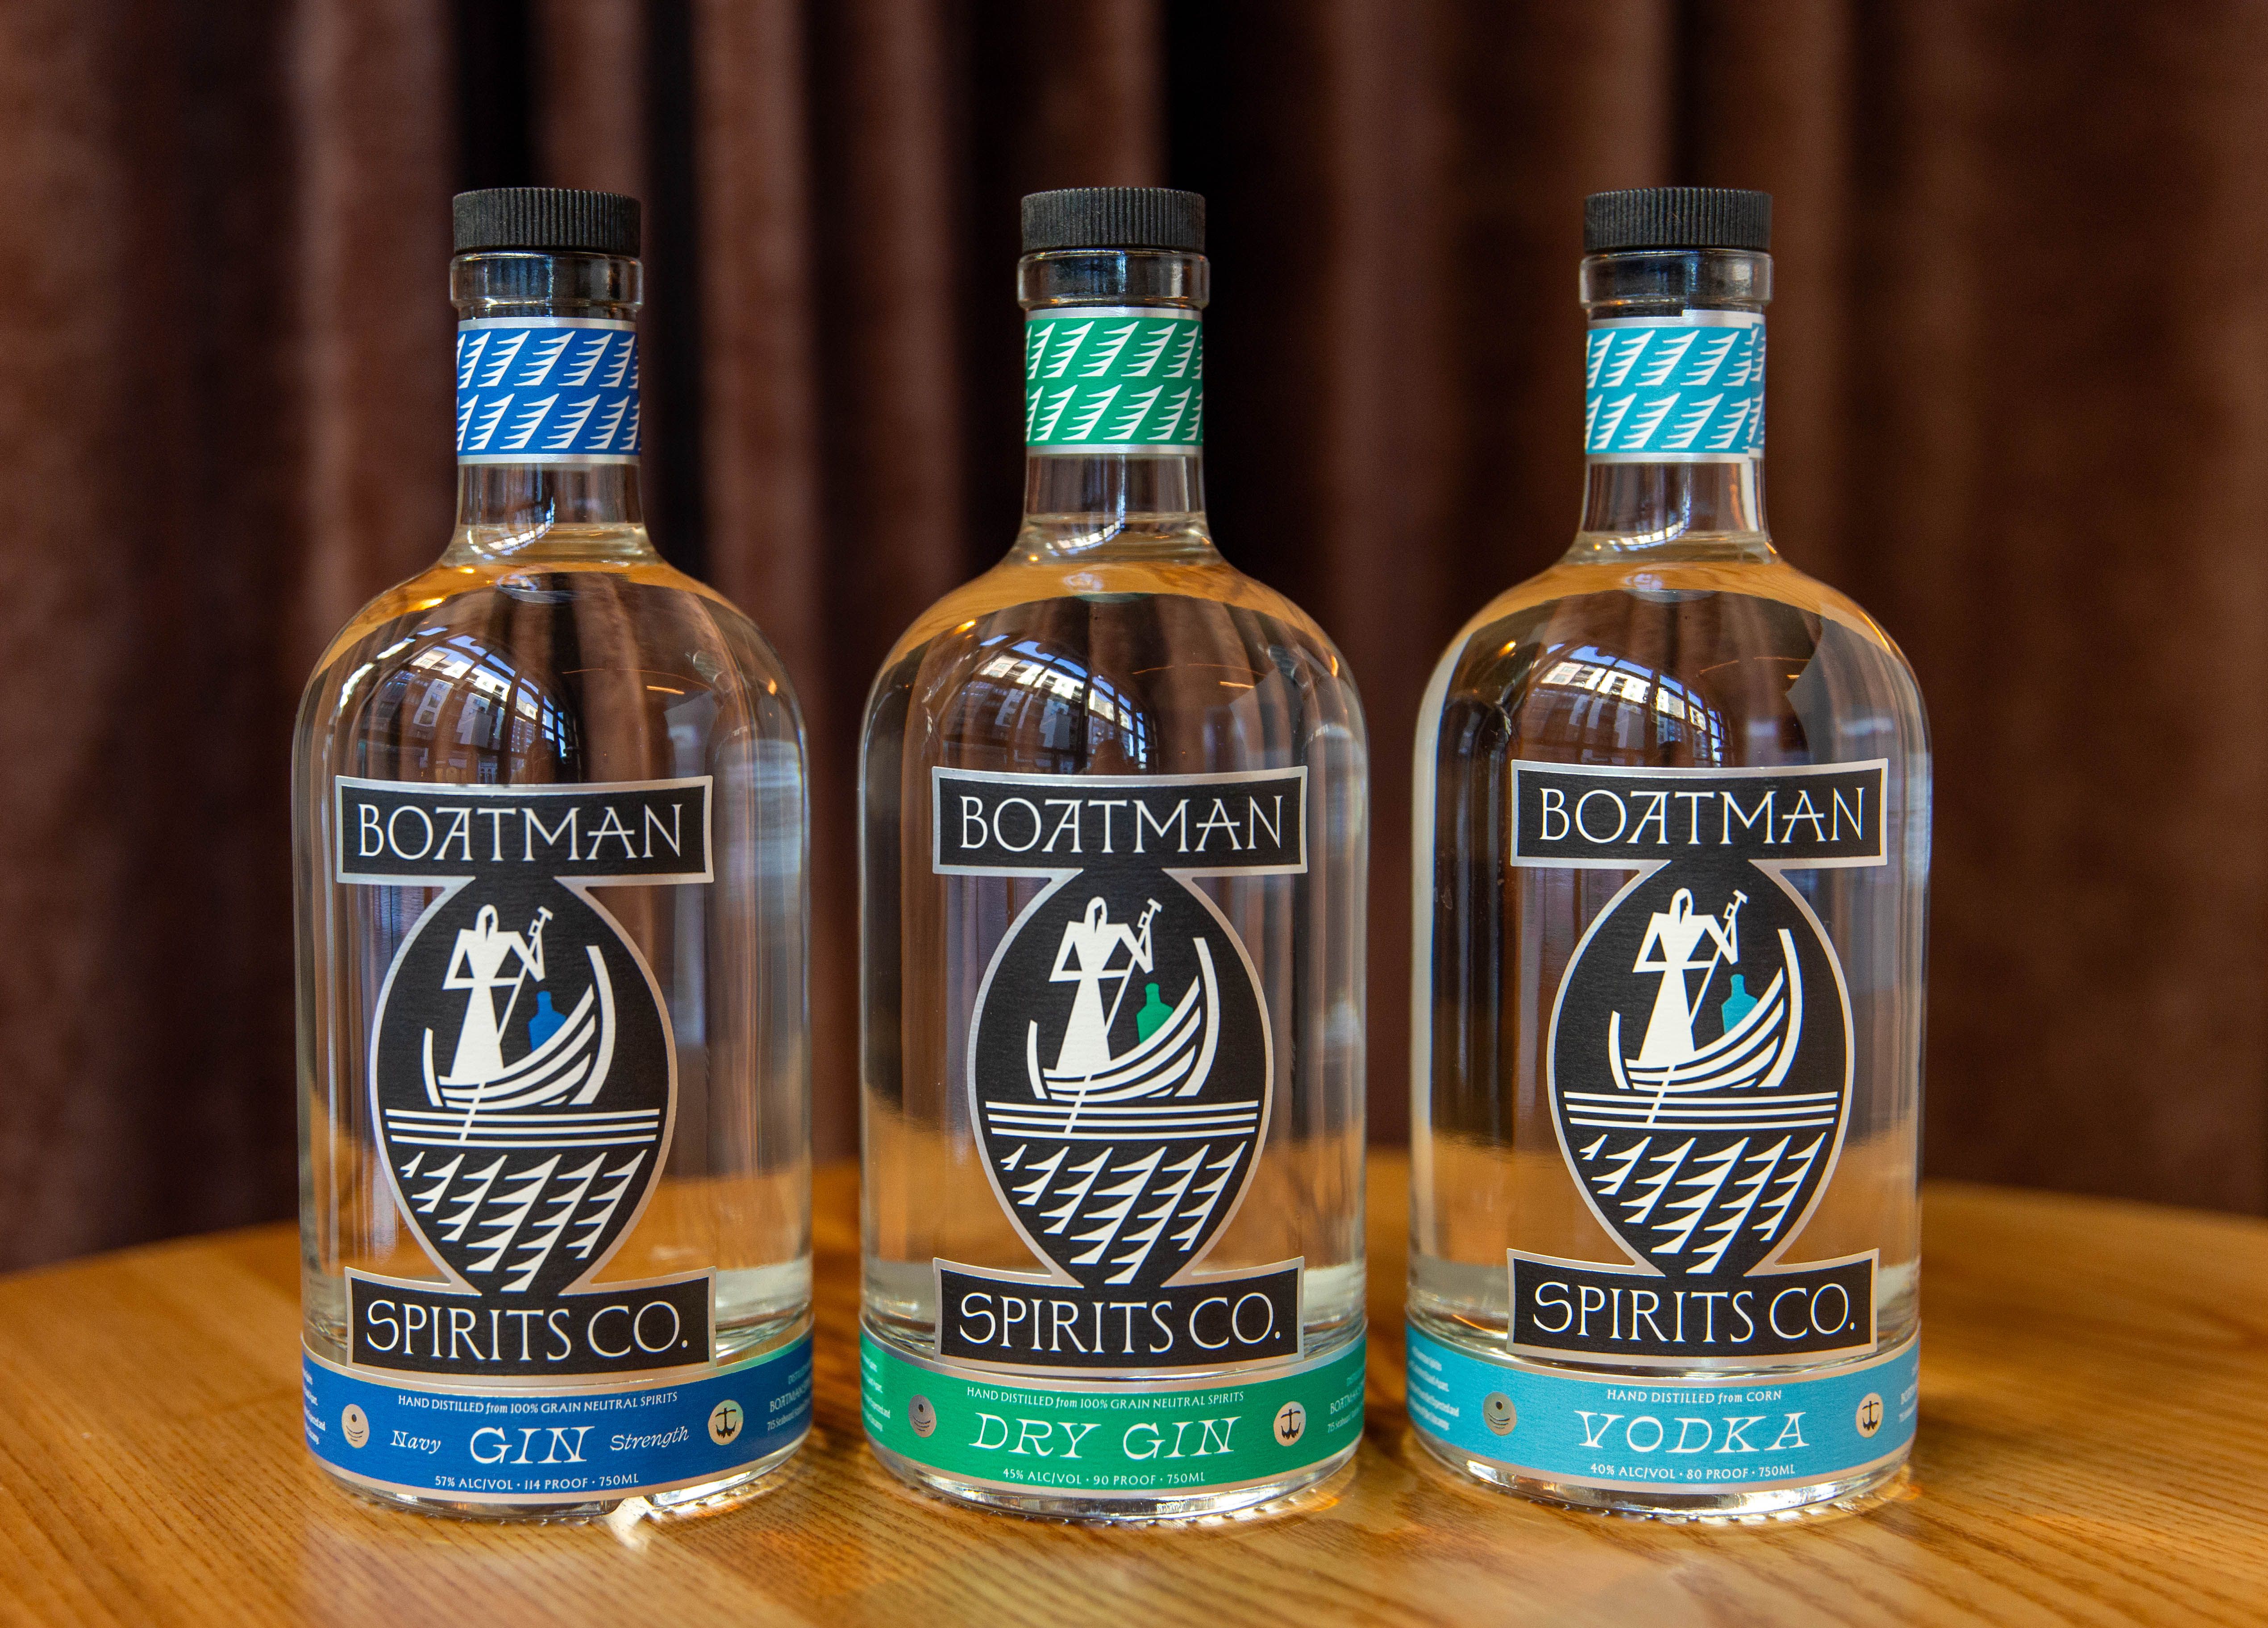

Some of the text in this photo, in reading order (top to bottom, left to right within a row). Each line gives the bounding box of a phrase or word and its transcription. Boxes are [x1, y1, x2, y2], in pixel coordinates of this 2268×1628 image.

[359, 804, 681, 861] BOATMAN
[960, 796, 1282, 852] BOATMAN
[1540, 788, 1864, 844] BOATMAN
[367, 1300, 687, 1360] SPIRITS CO.
[960, 1293, 1280, 1352] SPIRITS CO.
[1534, 1282, 1854, 1342] SPIRITS CO.
[399, 1392, 677, 1414] HAND DISTILLED from 100% GRAIN NEUTRAL SPIRITS
[968, 1387, 1243, 1408] HAND DISTILLED from 100% GRAIN NEUTRAL SPIRITS
[1607, 1389, 1781, 1404] HAND DISTILLED from CORN
[391, 1426, 689, 1463] Navy GIN Strength
[969, 1413, 1241, 1459] DRY GIN
[1574, 1411, 1809, 1453] VODKA
[436, 1474, 639, 1490] 57% ALC/VOL 114 PROOF 750ML
[1003, 1469, 1204, 1485] 45% ALC/VOL 90 PROOF 750ML
[1591, 1463, 1795, 1479] 40% ALC/VOL 80 PROOF 750ML
